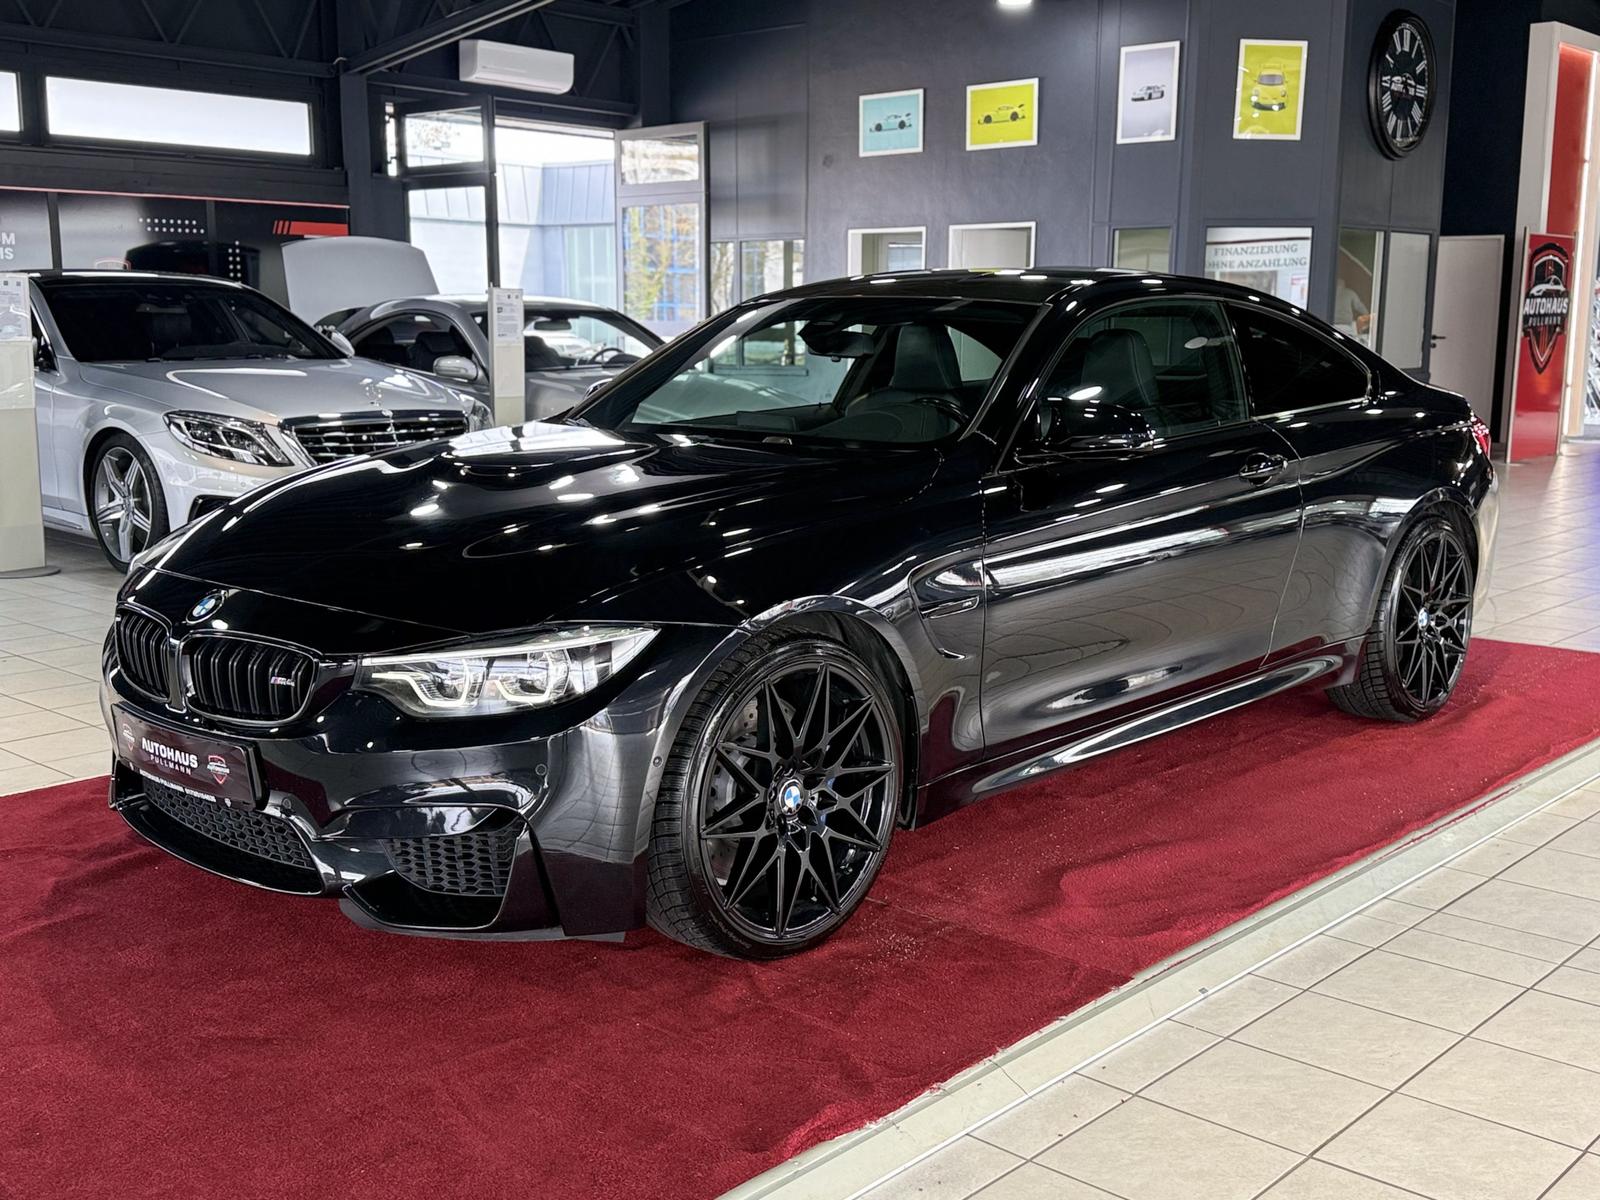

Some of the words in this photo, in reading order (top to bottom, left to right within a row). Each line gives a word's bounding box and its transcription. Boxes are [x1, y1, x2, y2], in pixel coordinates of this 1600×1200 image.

[0, 231, 16, 245] M
[1214, 243, 1299, 257] FINANZIERUNG
[1236, 256, 1308, 269] ANZAHLUNG
[1523, 297, 1569, 316] AUTOHAUS
[141, 737, 199, 769] AUTOHAUS
[150, 754, 192, 776] PULLMANN
